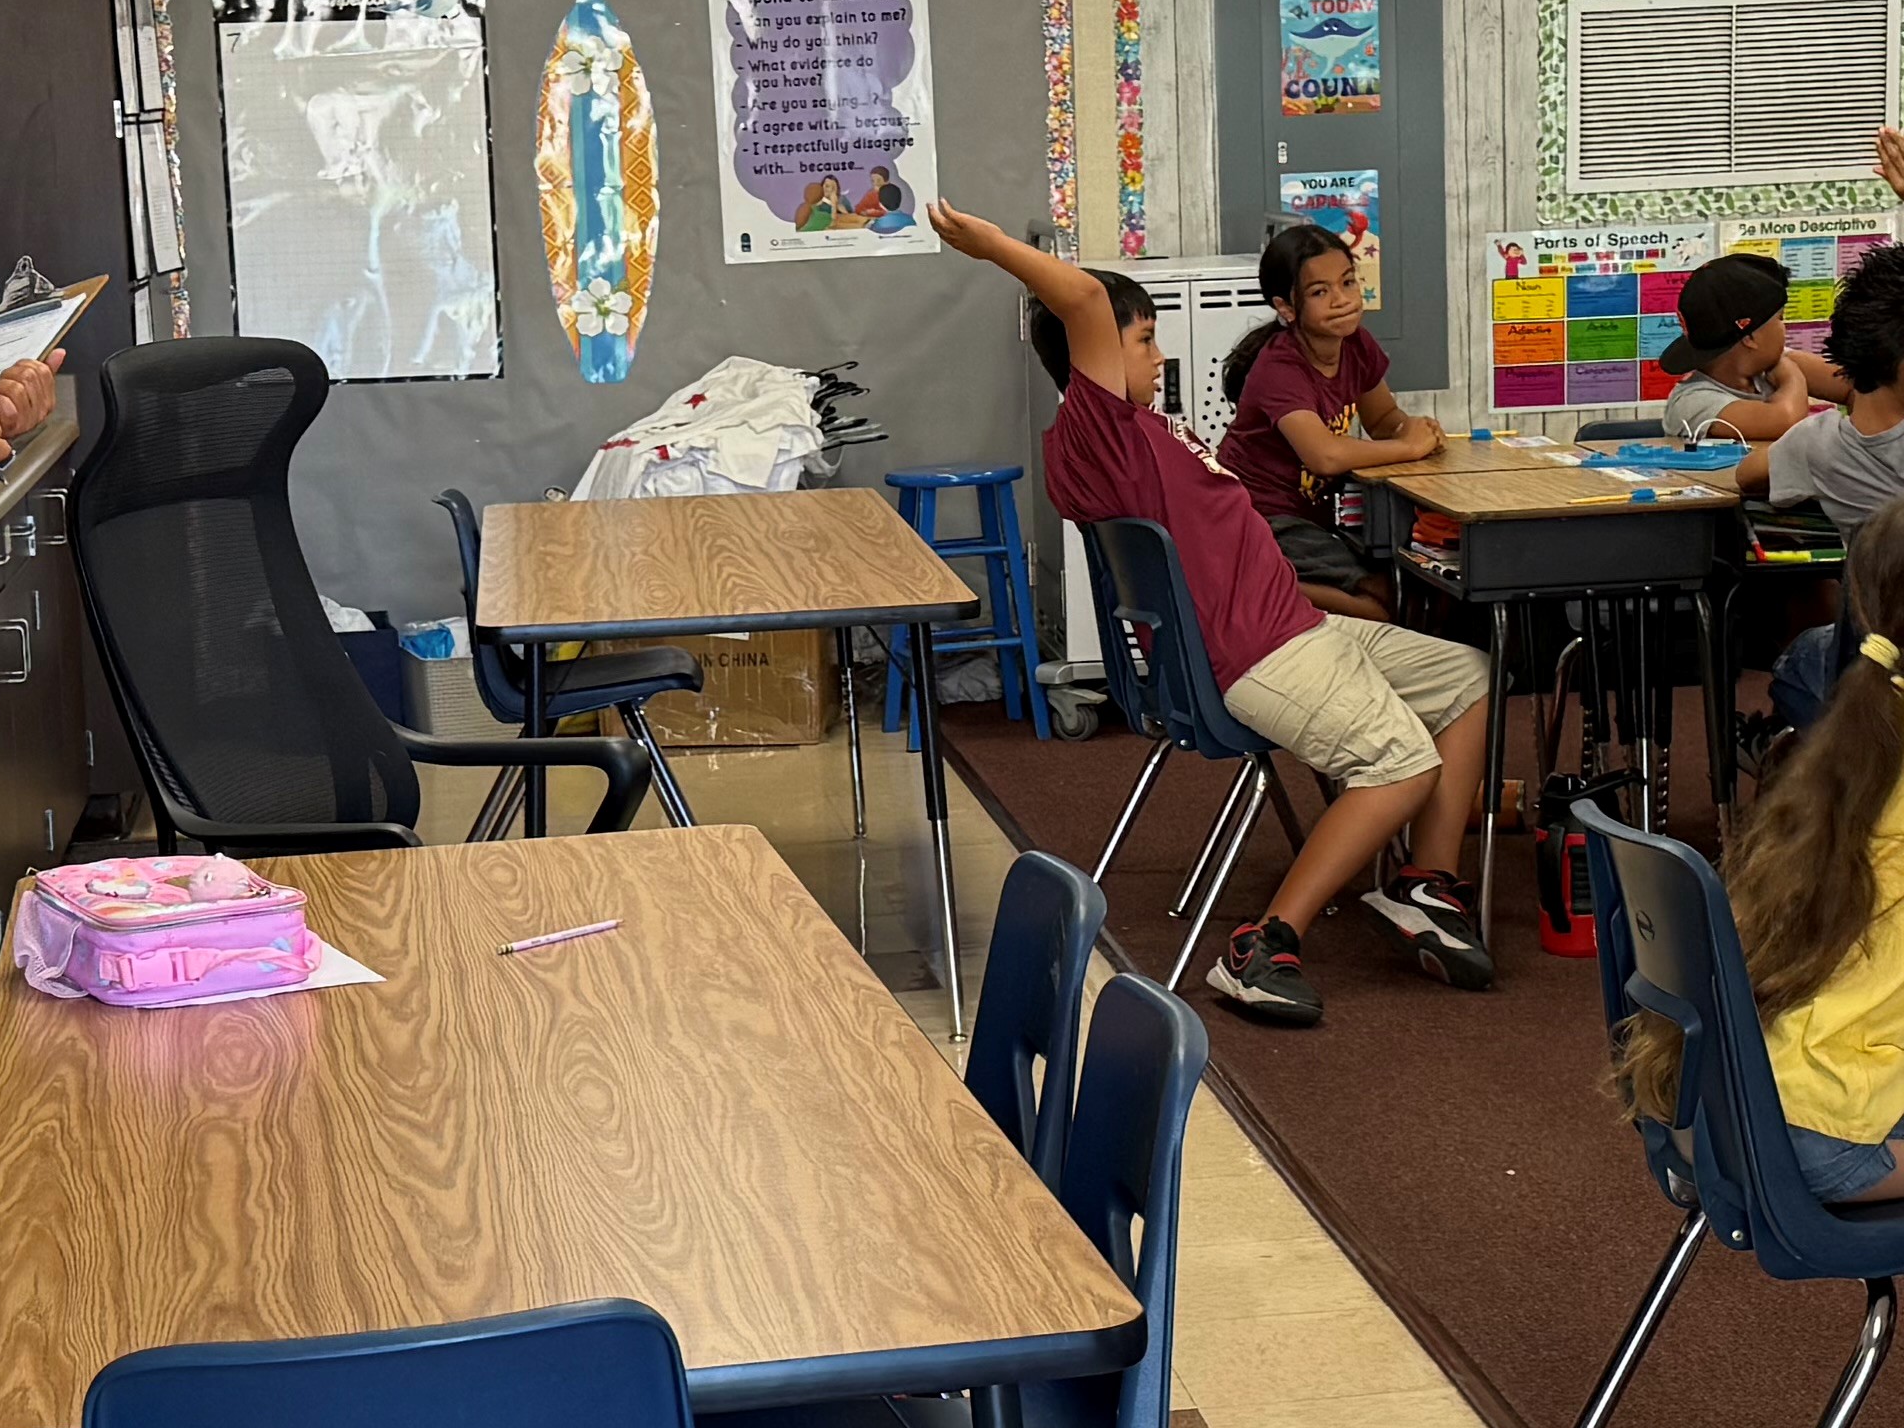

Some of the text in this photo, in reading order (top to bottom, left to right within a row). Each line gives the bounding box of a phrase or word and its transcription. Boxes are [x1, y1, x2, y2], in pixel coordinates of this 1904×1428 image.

[749, 8, 907, 30] an you explain to me?
[226, 32, 241, 54] 7
[747, 32, 879, 52] Why do you think?
[748, 58, 786, 73] What
[856, 56, 874, 67] do
[753, 73, 823, 93] you have?
[1284, 77, 1379, 100] COUNT
[751, 98, 777, 111] Are
[781, 99, 807, 113] you
[752, 121, 759, 134] I
[762, 120, 804, 136] agree
[752, 135, 915, 155] I respectfully disagree
[1301, 176, 1356, 190] YOU ARE
[1760, 220, 1796, 235] More
[1799, 218, 1877, 234] Descriptive
[1534, 231, 1669, 250] Parts of Speech
[1516, 281, 1542, 291] Noun
